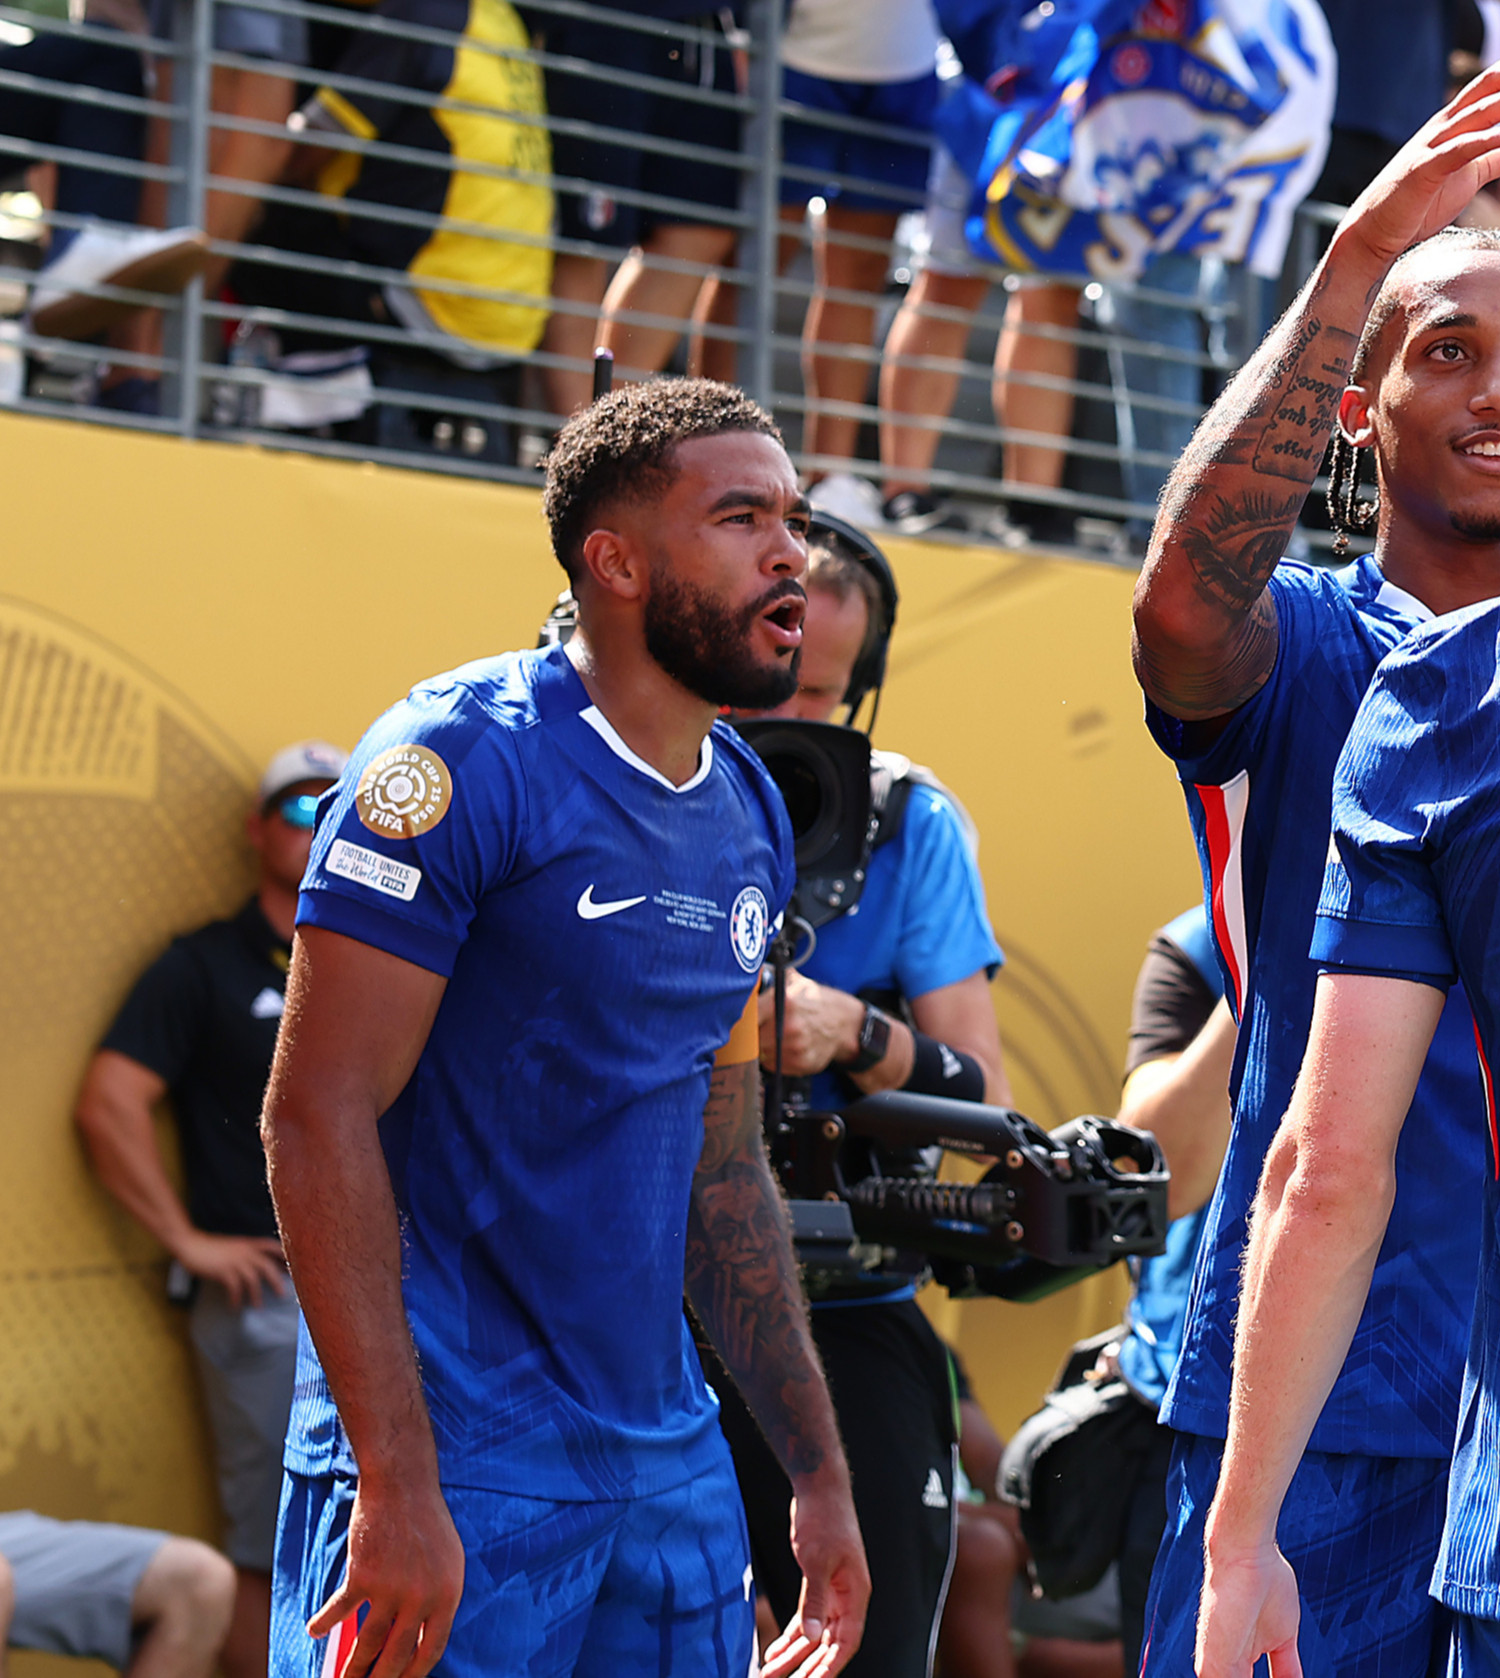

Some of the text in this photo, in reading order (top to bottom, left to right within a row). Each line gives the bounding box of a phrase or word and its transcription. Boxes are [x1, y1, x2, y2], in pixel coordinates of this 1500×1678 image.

[375, 753, 420, 772] WORLD
[421, 760, 441, 783] CUP
[430, 786, 442, 803] 25
[368, 807, 405, 833] FIFA
[410, 803, 436, 825] USA
[336, 858, 380, 885] the World
[340, 845, 411, 880] FOOTBALL UNITES
[381, 876, 406, 893] FIFA
